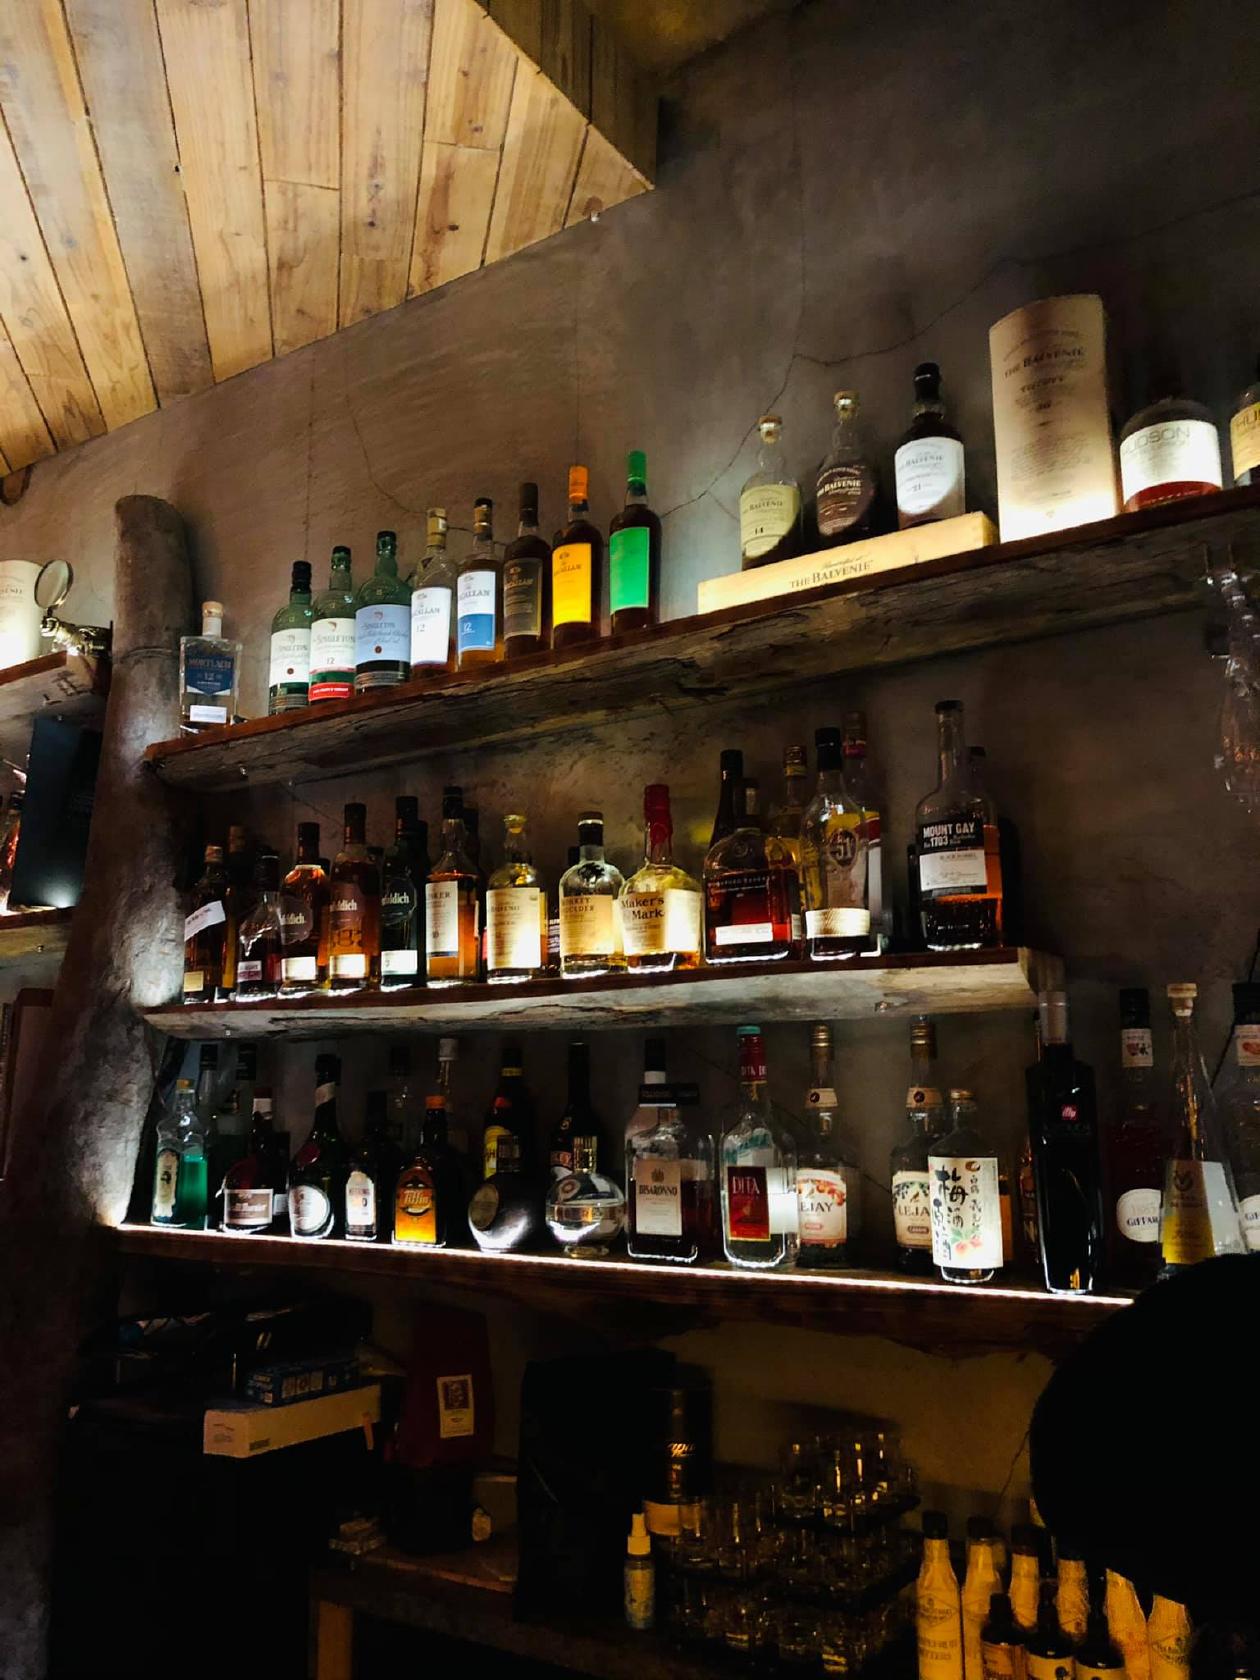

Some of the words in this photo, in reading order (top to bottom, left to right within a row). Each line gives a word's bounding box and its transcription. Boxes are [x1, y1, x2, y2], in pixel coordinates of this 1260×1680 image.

[790, 579, 811, 590] THE
[812, 562, 871, 584] BALVENIE
[923, 824, 953, 839] MOUNT
[955, 822, 976, 836] GAY
[621, 896, 665, 909] Maker's
[632, 908, 665, 921] Mark
[638, 1184, 679, 1197] DISARONNO
[731, 1175, 760, 1194] DITA
[799, 1201, 834, 1213] EJAY
[897, 1206, 931, 1217] LEJA
[1126, 1216, 1161, 1226] GiFFAR
